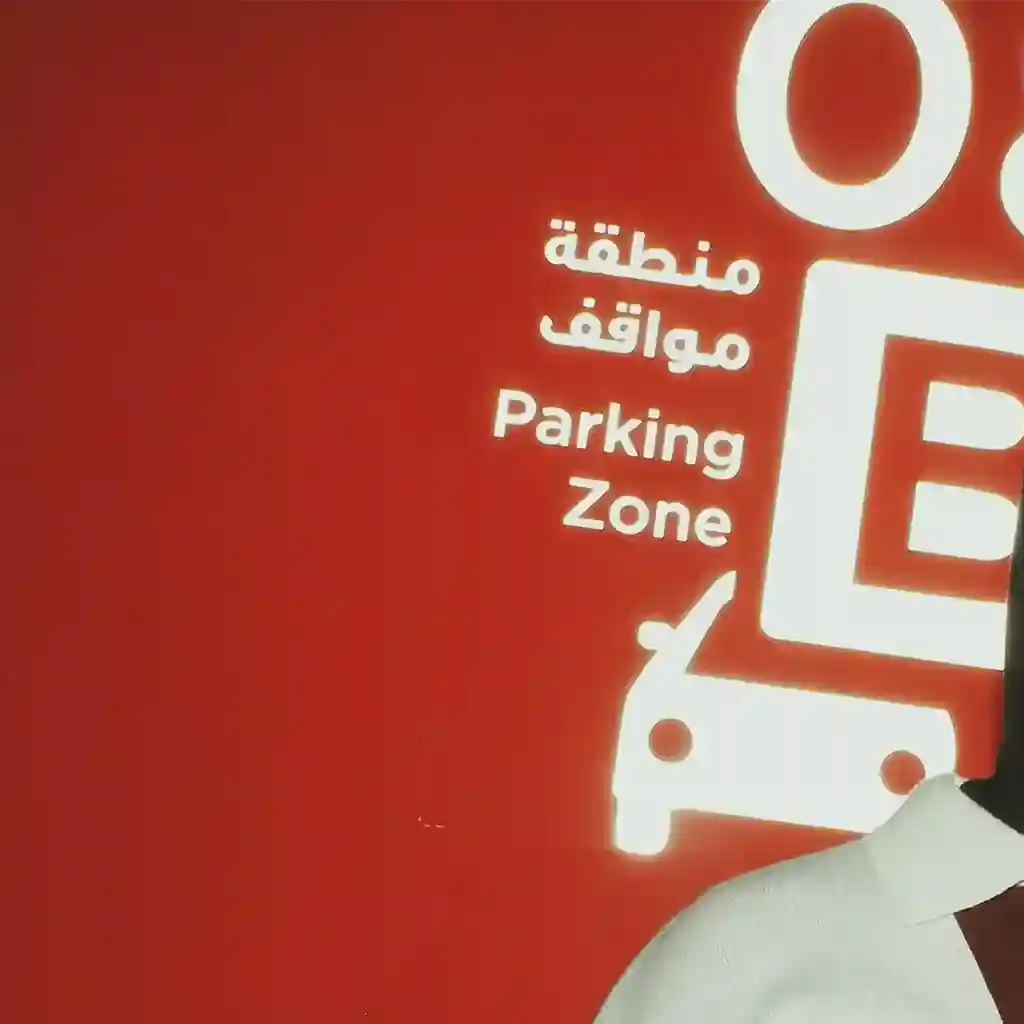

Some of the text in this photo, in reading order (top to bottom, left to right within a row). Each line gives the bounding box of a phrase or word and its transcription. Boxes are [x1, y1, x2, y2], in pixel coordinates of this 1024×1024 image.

[543, 219, 761, 297] منطقة
[539, 297, 752, 373] مواقف
[493, 388, 745, 481] Parking
[562, 476, 734, 548] Zone
